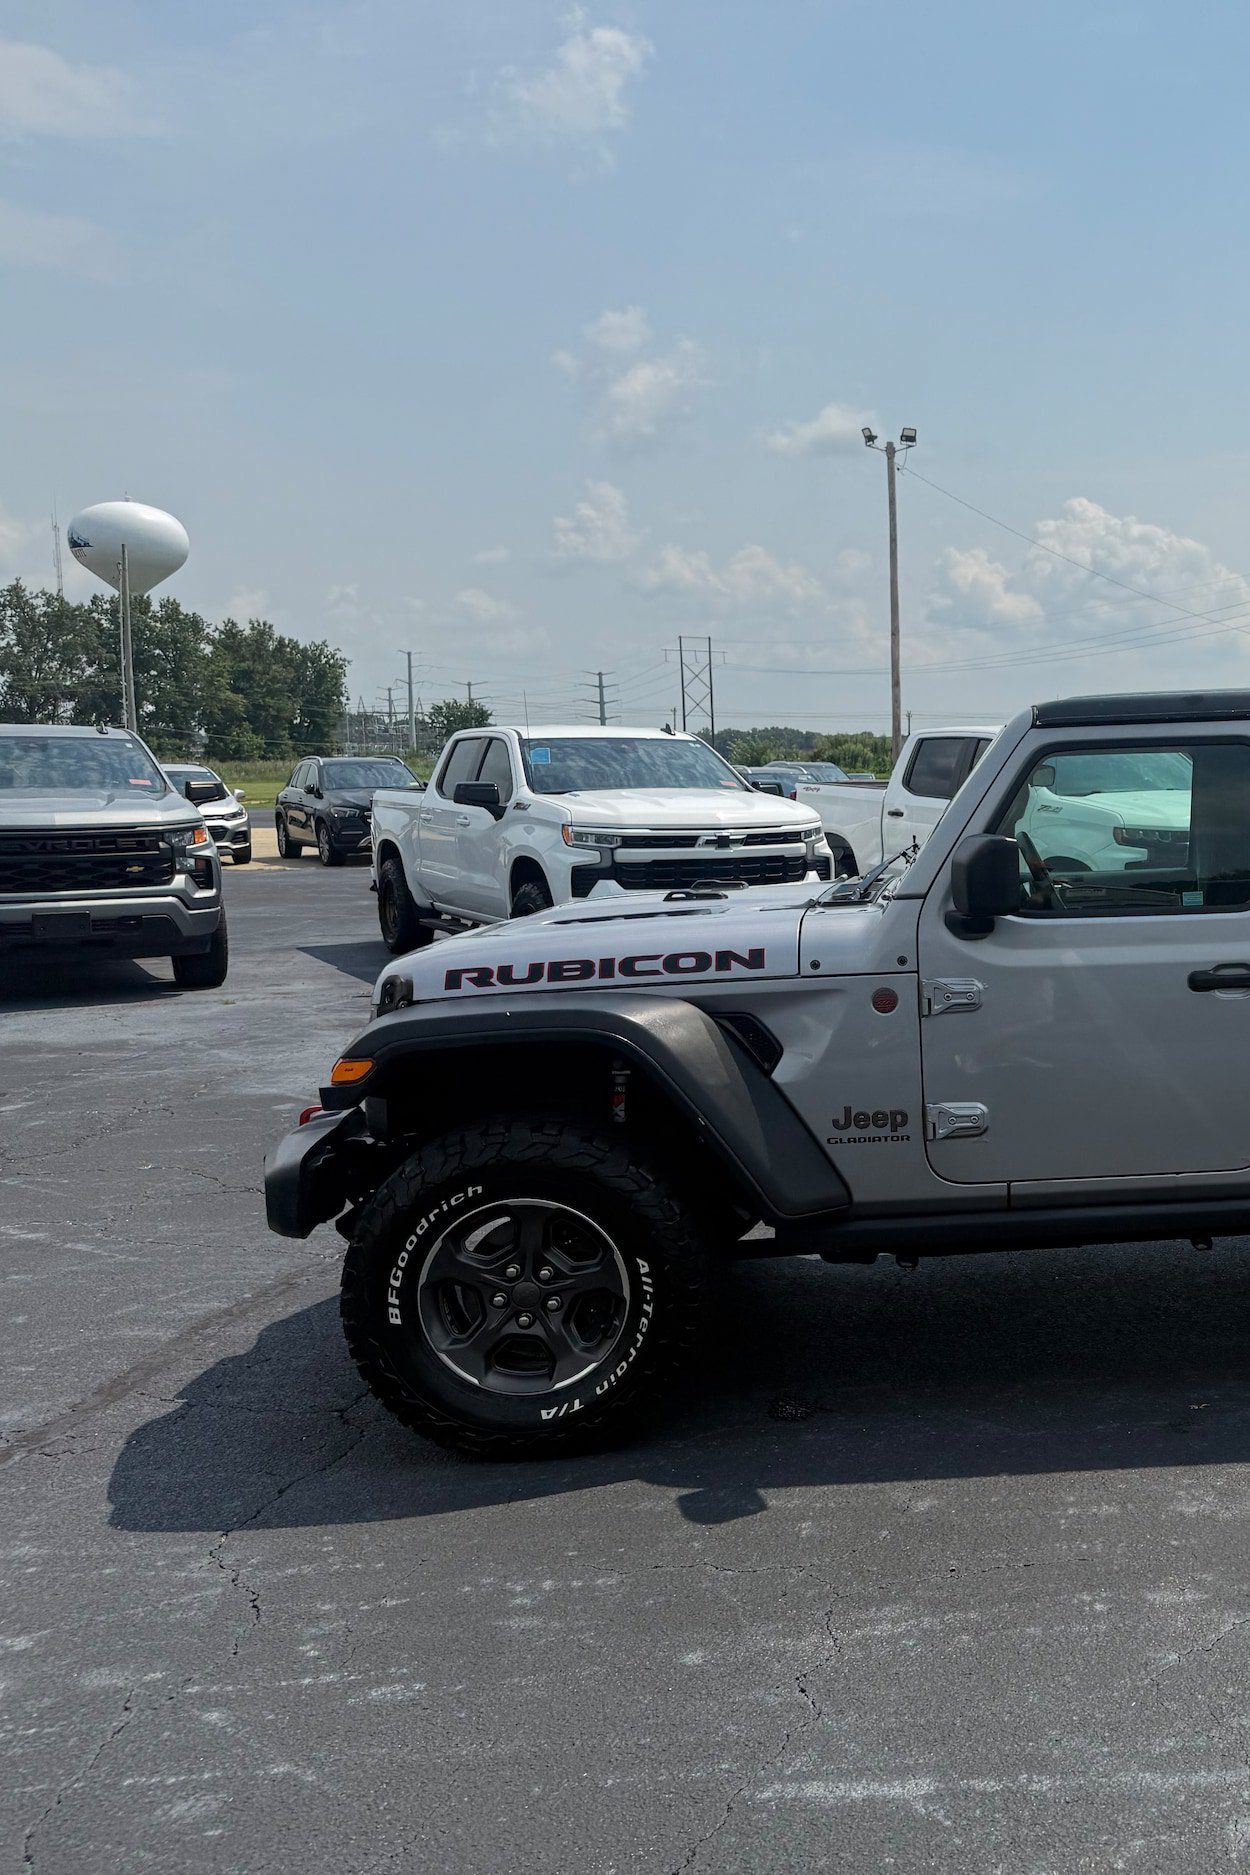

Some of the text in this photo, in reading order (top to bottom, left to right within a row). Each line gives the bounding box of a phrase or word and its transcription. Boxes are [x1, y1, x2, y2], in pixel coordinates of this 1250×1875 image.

[444, 948, 765, 990] RUBICON
[827, 1135, 911, 1144] GLADIATOR
[832, 1106, 908, 1132] Jeep
[388, 1185, 483, 1325] BFGoodrich
[540, 1257, 654, 1421] All-Terrain T/A
